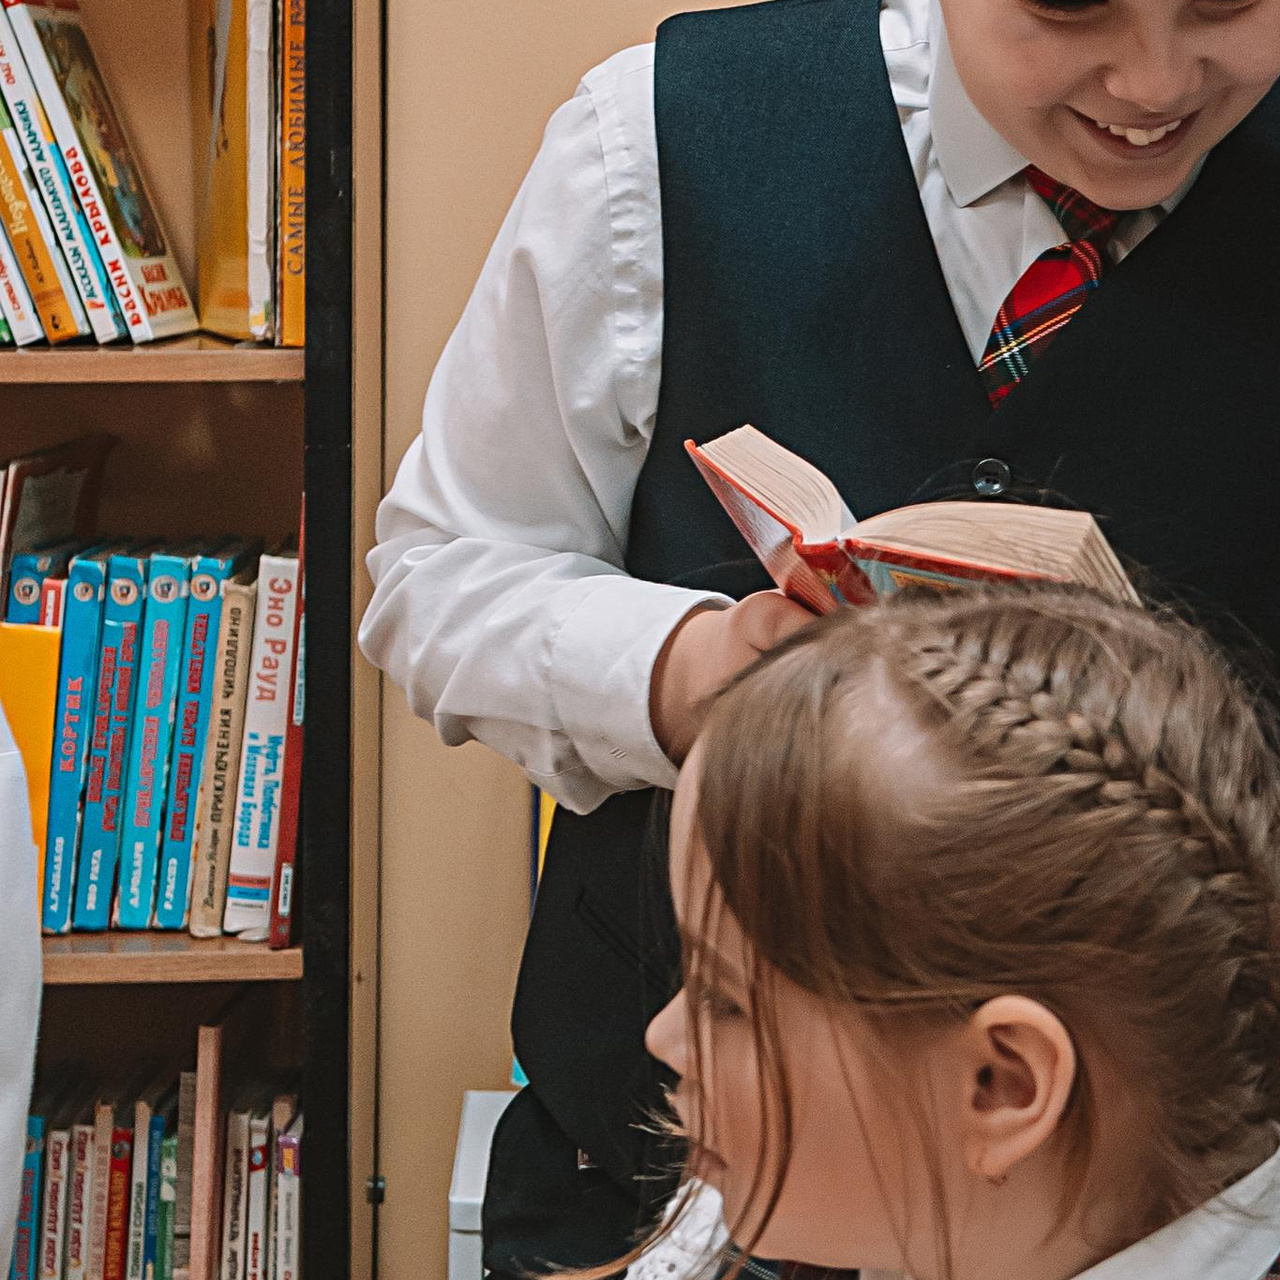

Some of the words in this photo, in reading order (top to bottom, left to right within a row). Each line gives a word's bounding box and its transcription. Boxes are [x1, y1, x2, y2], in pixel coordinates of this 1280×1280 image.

[286, 39, 305, 169] ЛЮБИМЫЕ
[64, 145, 113, 247] КРЫЛОВА
[285, 184, 304, 277] САМЫЕ
[107, 259, 143, 327] БАСНИ
[264, 577, 293, 628] Эно
[209, 708, 232, 824] ПРИКЛЮЧЕНИЯ
[221, 606, 242, 700] ЧИПОЛЛИНО
[254, 637, 288, 703] Рауд
[59, 675, 83, 773] КОРТИК
